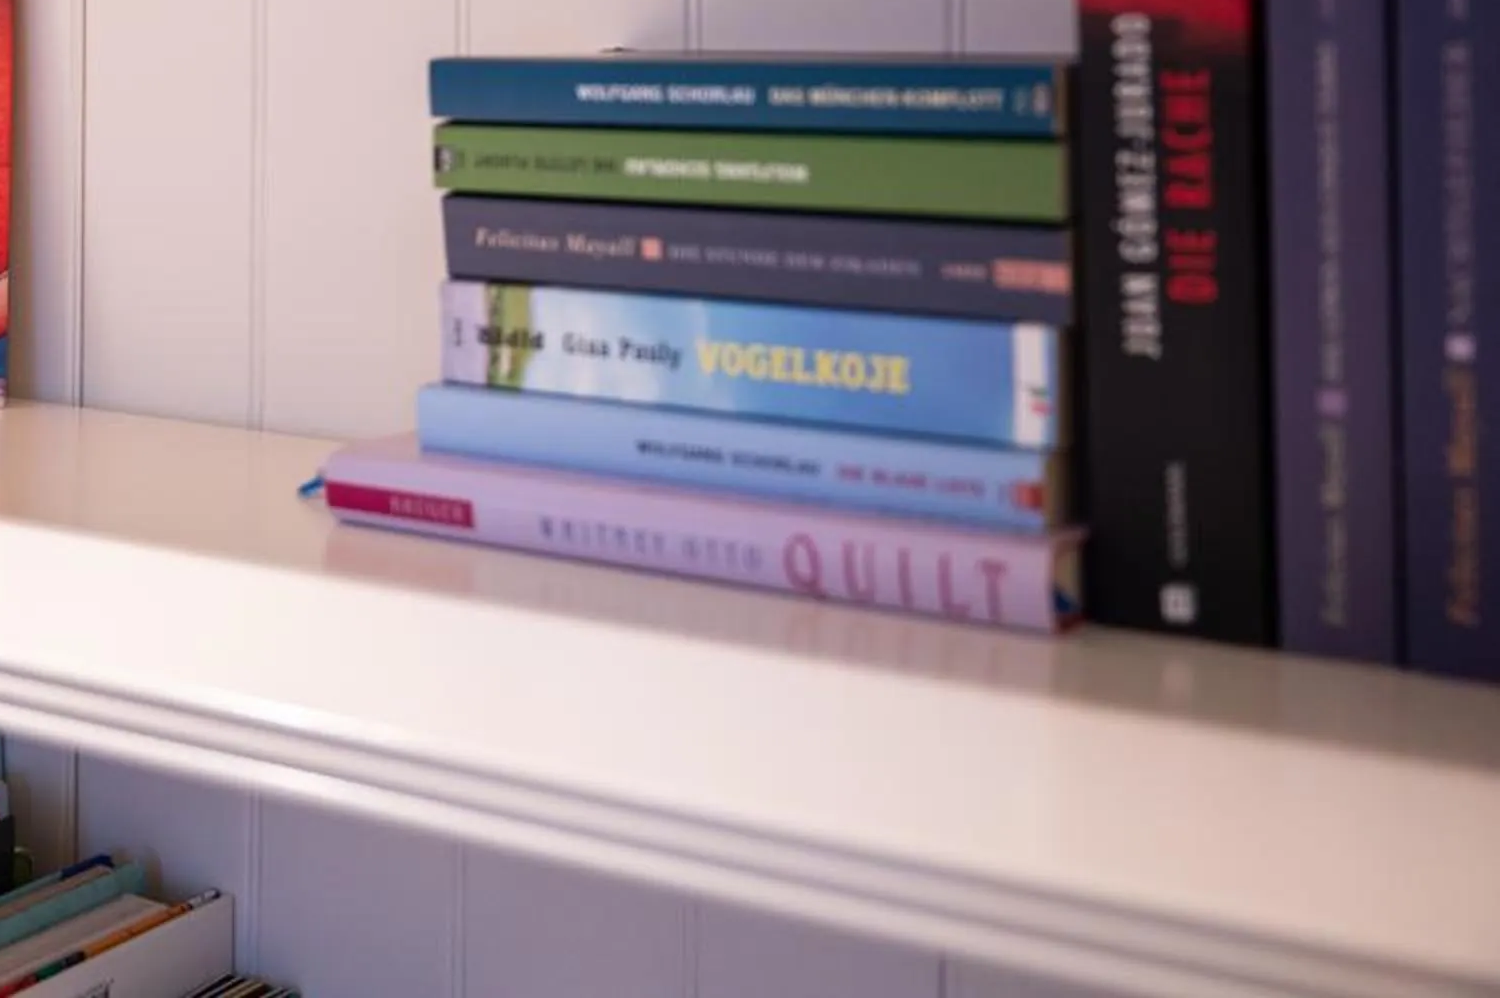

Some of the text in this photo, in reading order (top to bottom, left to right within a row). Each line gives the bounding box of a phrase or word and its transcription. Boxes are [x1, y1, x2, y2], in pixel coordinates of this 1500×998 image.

[1160, 68, 1218, 304] DIE RACHE
[1119, 272, 1163, 360] JUAN
[617, 335, 684, 371] Pauly
[694, 337, 913, 395] VOGELKOJE
[781, 532, 1011, 623] QUILT
